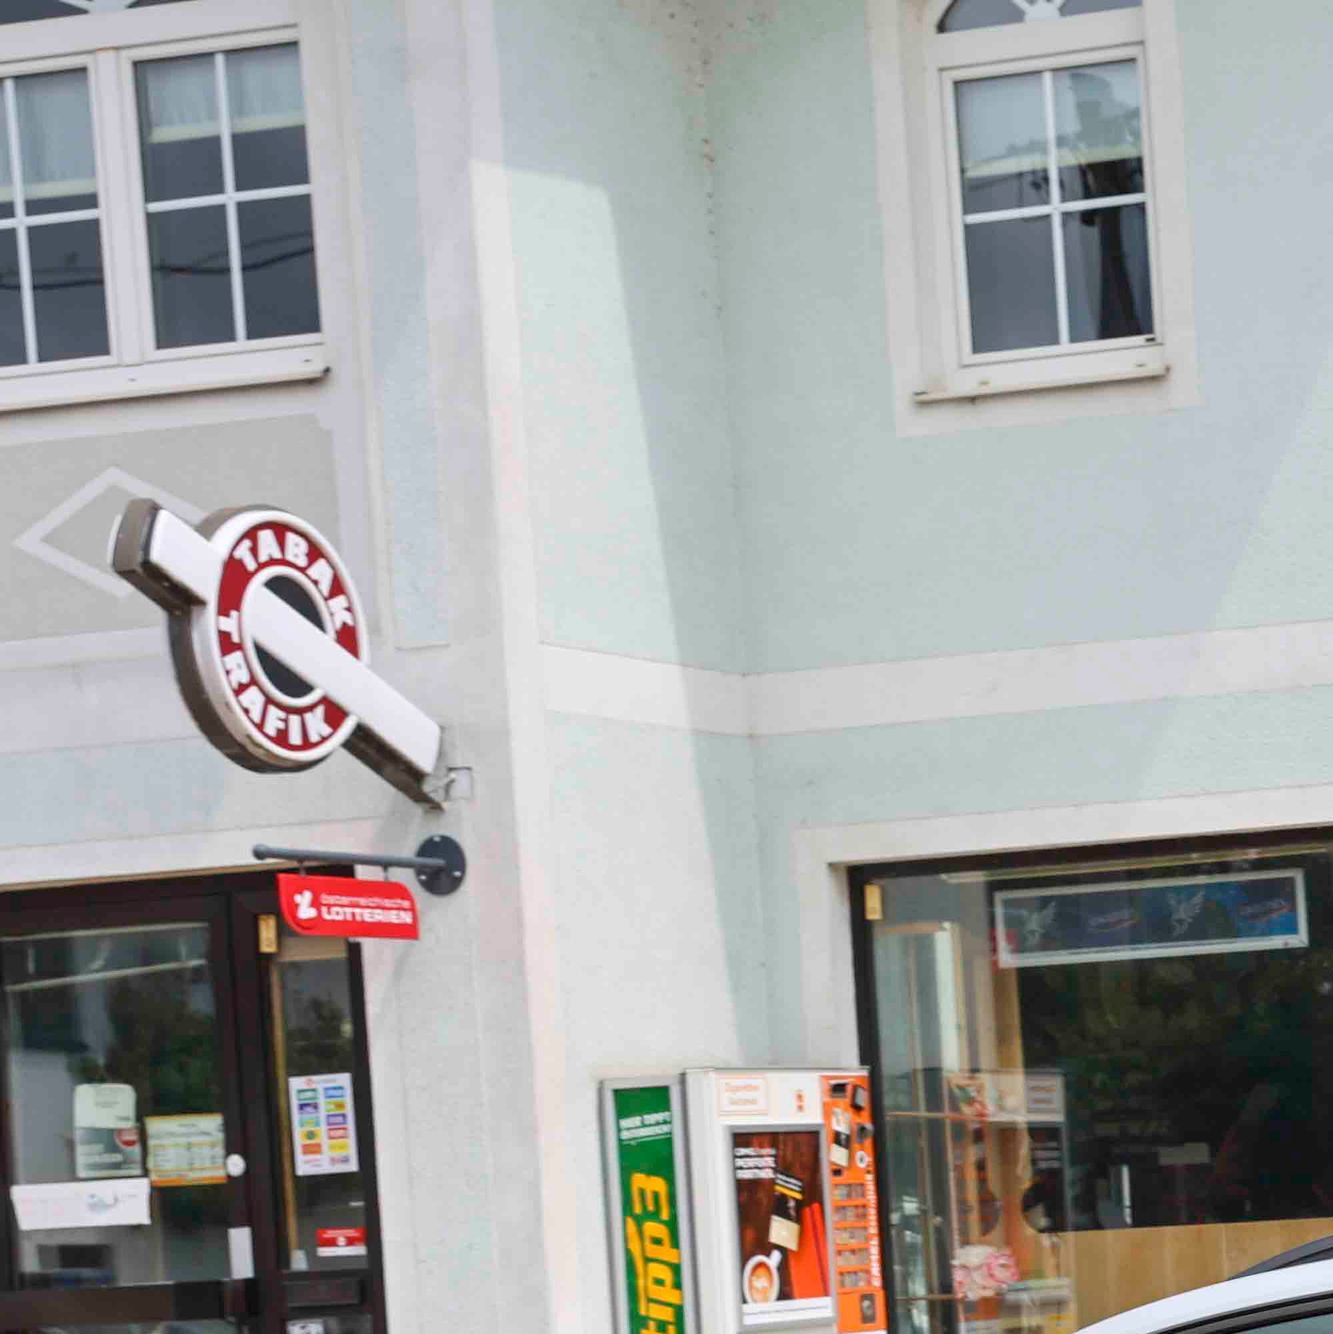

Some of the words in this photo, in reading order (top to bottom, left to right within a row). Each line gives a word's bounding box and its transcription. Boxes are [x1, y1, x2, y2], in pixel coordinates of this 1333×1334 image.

[232, 528, 355, 632] TABAK
[217, 609, 334, 745] TRAFIK
[320, 905, 413, 924] LOTTERIEN
